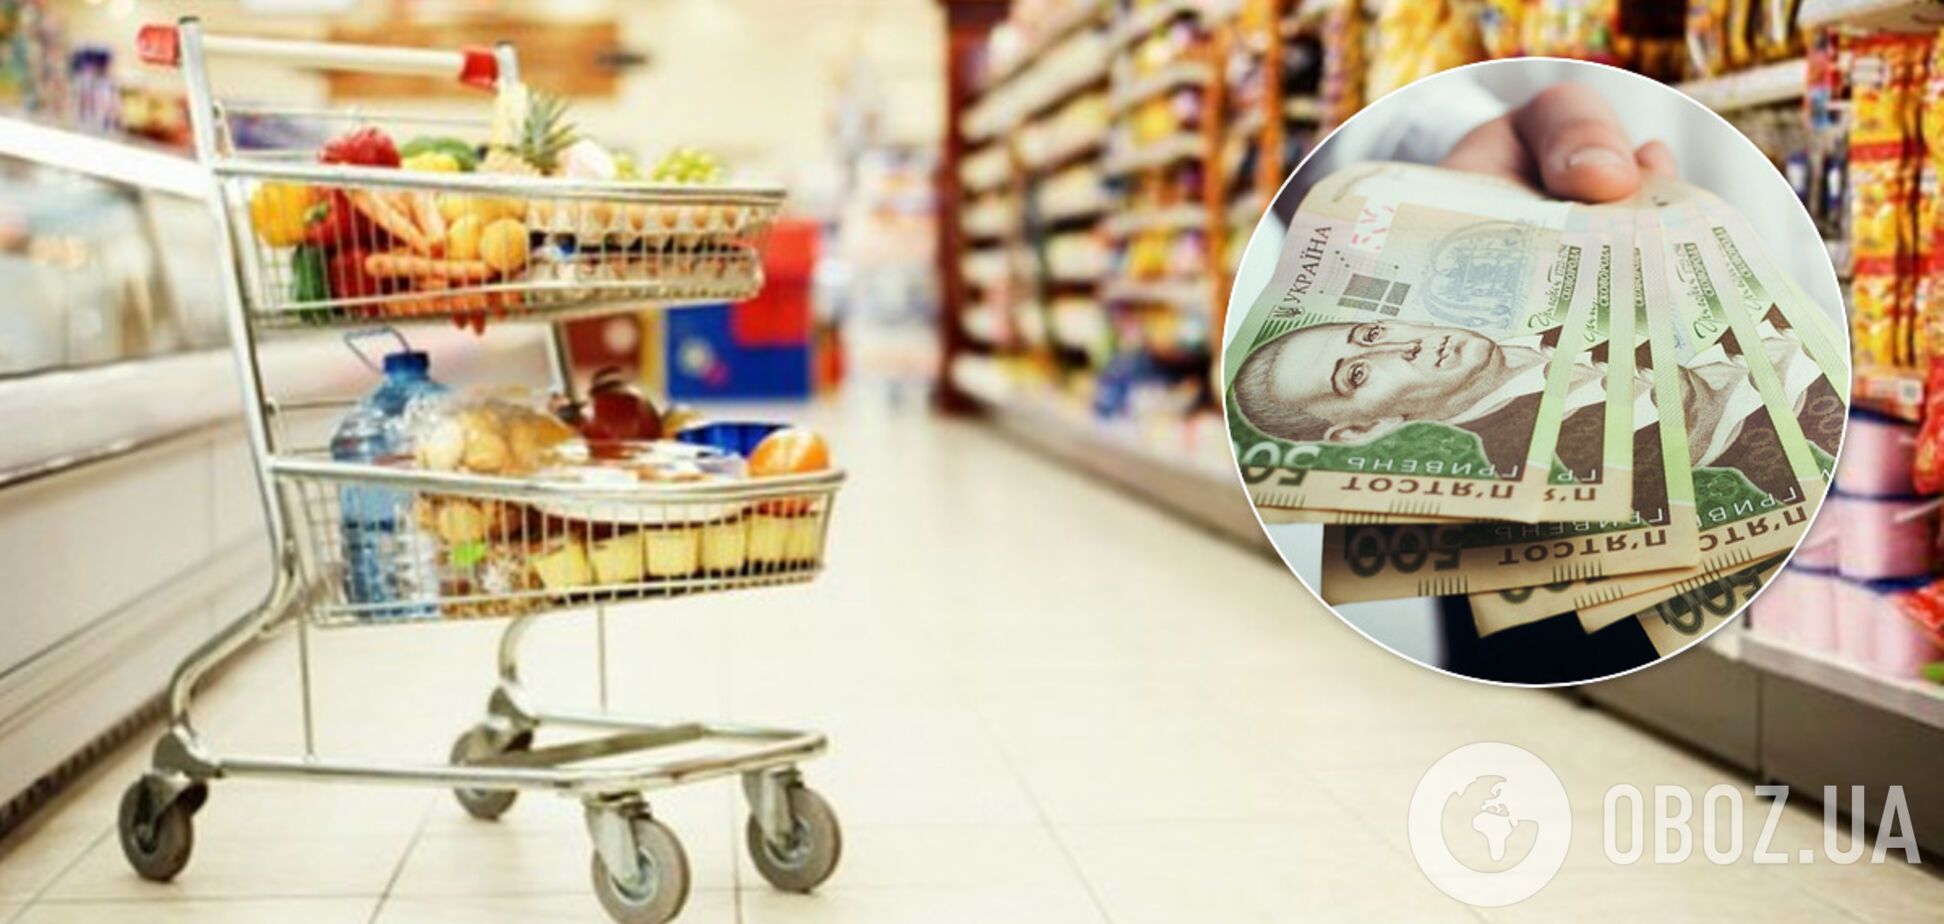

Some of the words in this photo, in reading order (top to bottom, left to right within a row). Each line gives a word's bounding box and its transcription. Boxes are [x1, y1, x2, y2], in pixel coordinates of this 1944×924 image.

[1283, 225, 1332, 304] УКРАЇНА
[1230, 441, 1322, 487] 50
[1347, 456, 1519, 478] ГРИВЕНЬ
[1340, 476, 1514, 500] П'ЯТСОТ
[1345, 526, 1463, 578] 500
[1498, 528, 1667, 566] П'ЯТСОТ
